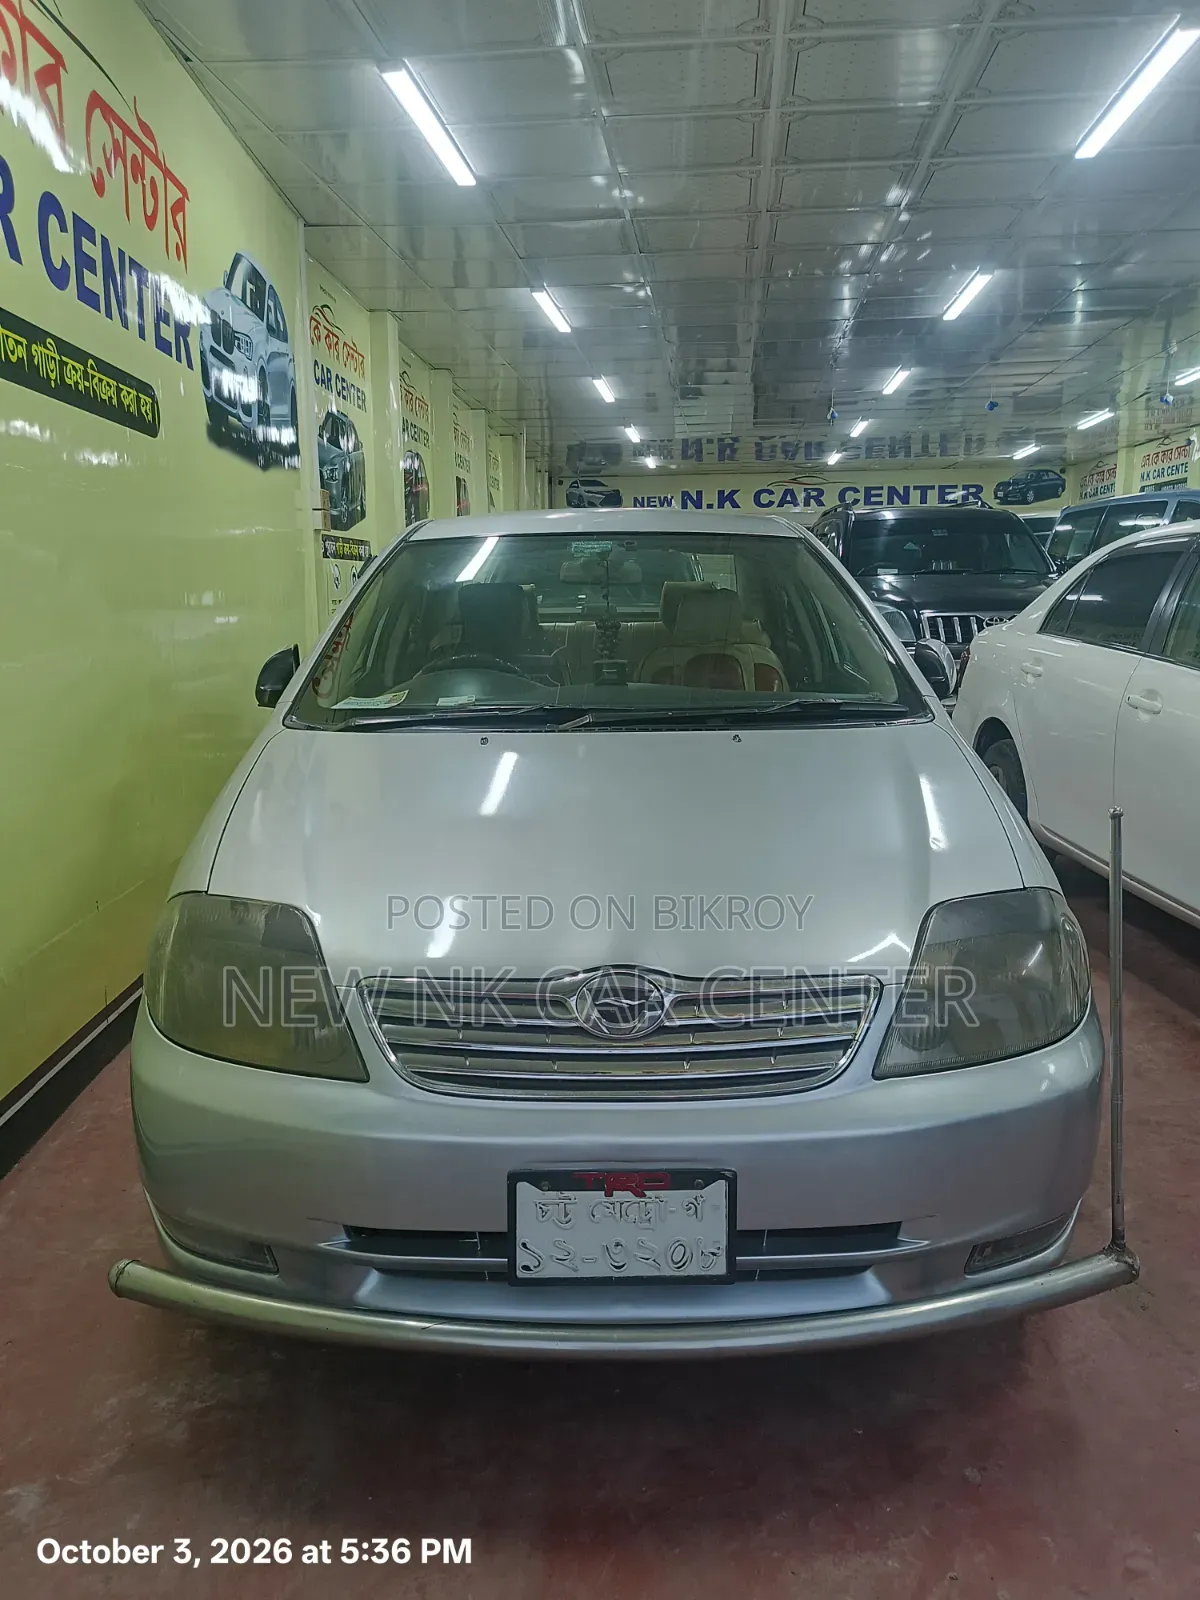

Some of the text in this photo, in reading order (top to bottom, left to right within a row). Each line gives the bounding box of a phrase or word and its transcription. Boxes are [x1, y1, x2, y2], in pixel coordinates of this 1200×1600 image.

[86, 89, 190, 274] সেন্টার
[38, 191, 194, 371] CENTER
[313, 359, 333, 394] CAR
[335, 372, 367, 413] CENTER
[1152, 467, 1166, 480] CAR
[633, 484, 984, 510] NEW N.K CAR CENTER
[574, 1172, 671, 1198] TRD
